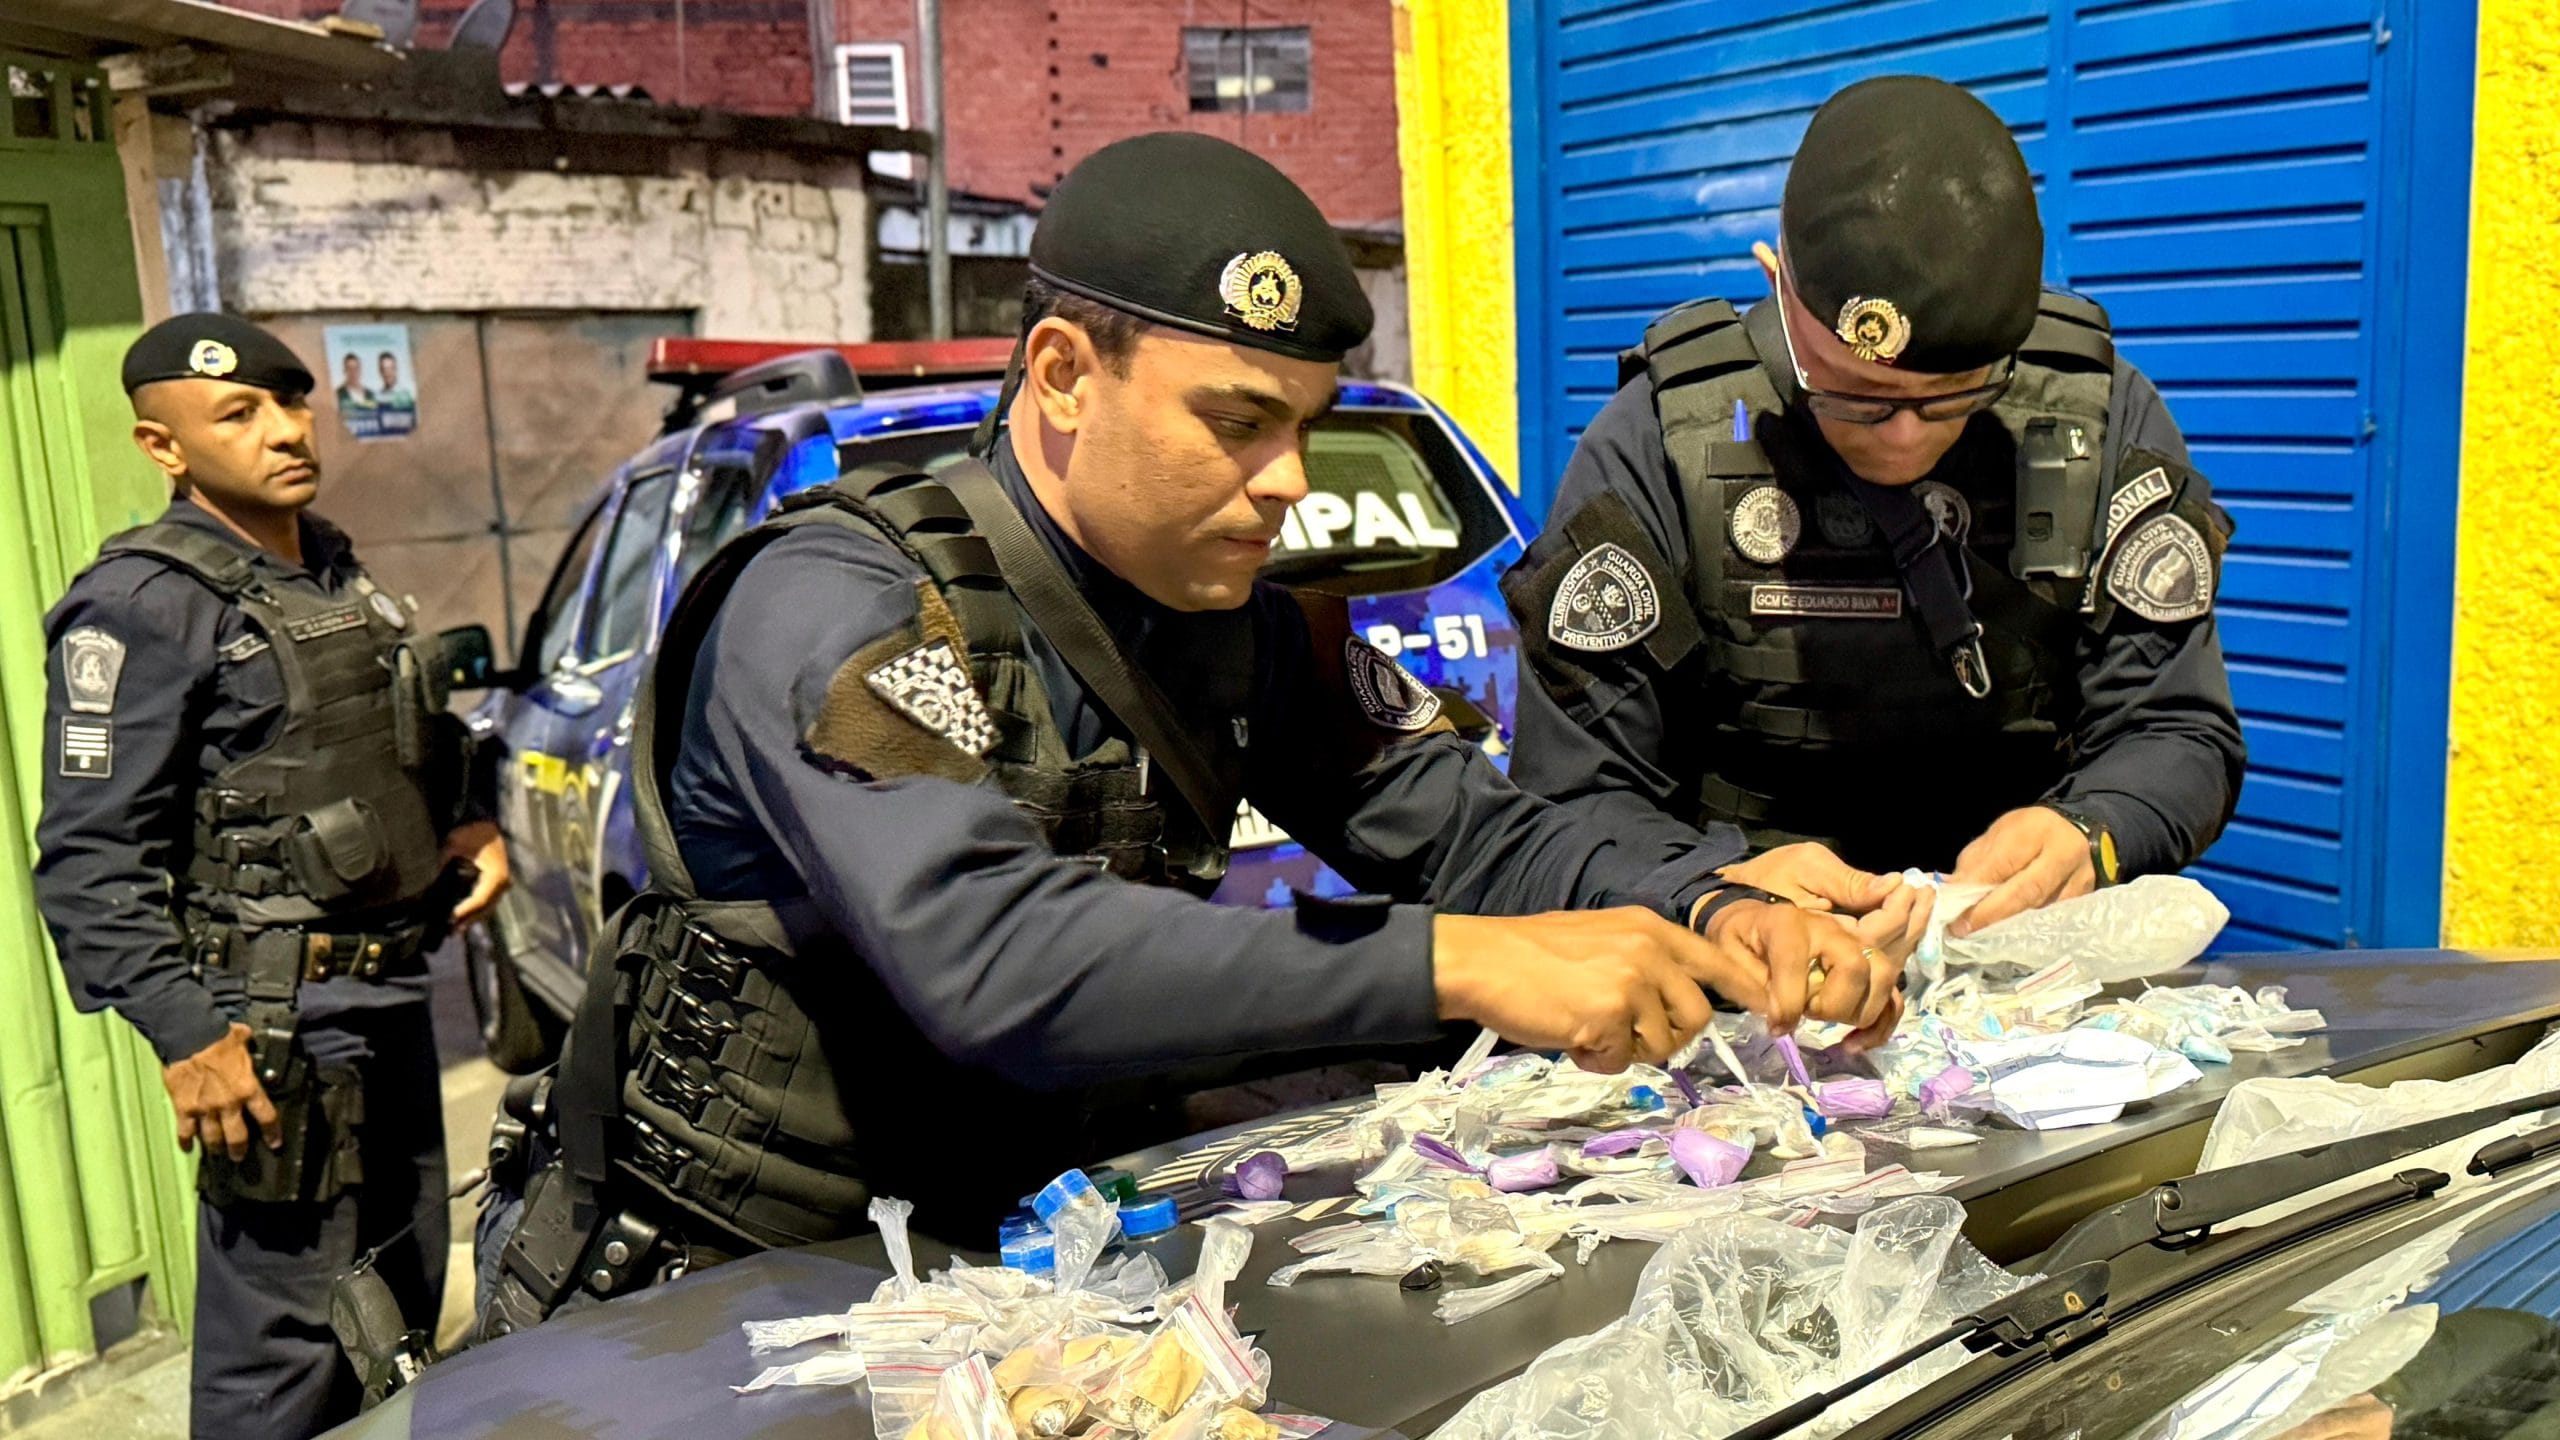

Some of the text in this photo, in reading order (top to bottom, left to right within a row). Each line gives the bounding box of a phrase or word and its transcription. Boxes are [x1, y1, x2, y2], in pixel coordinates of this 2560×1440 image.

[1270, 491, 1459, 550] IPAL
[1607, 551, 1654, 620] GUARDA CIVIL
[2114, 540, 2143, 586] GUARDA
[2140, 523, 2169, 541] CIVIL
[1554, 564, 1627, 648] POLICIAMENTO PREVENTIVO
[1756, 593, 1780, 608] GCM
[1798, 595, 1849, 609] EDUARDO
[1851, 597, 1879, 609] SILVA
